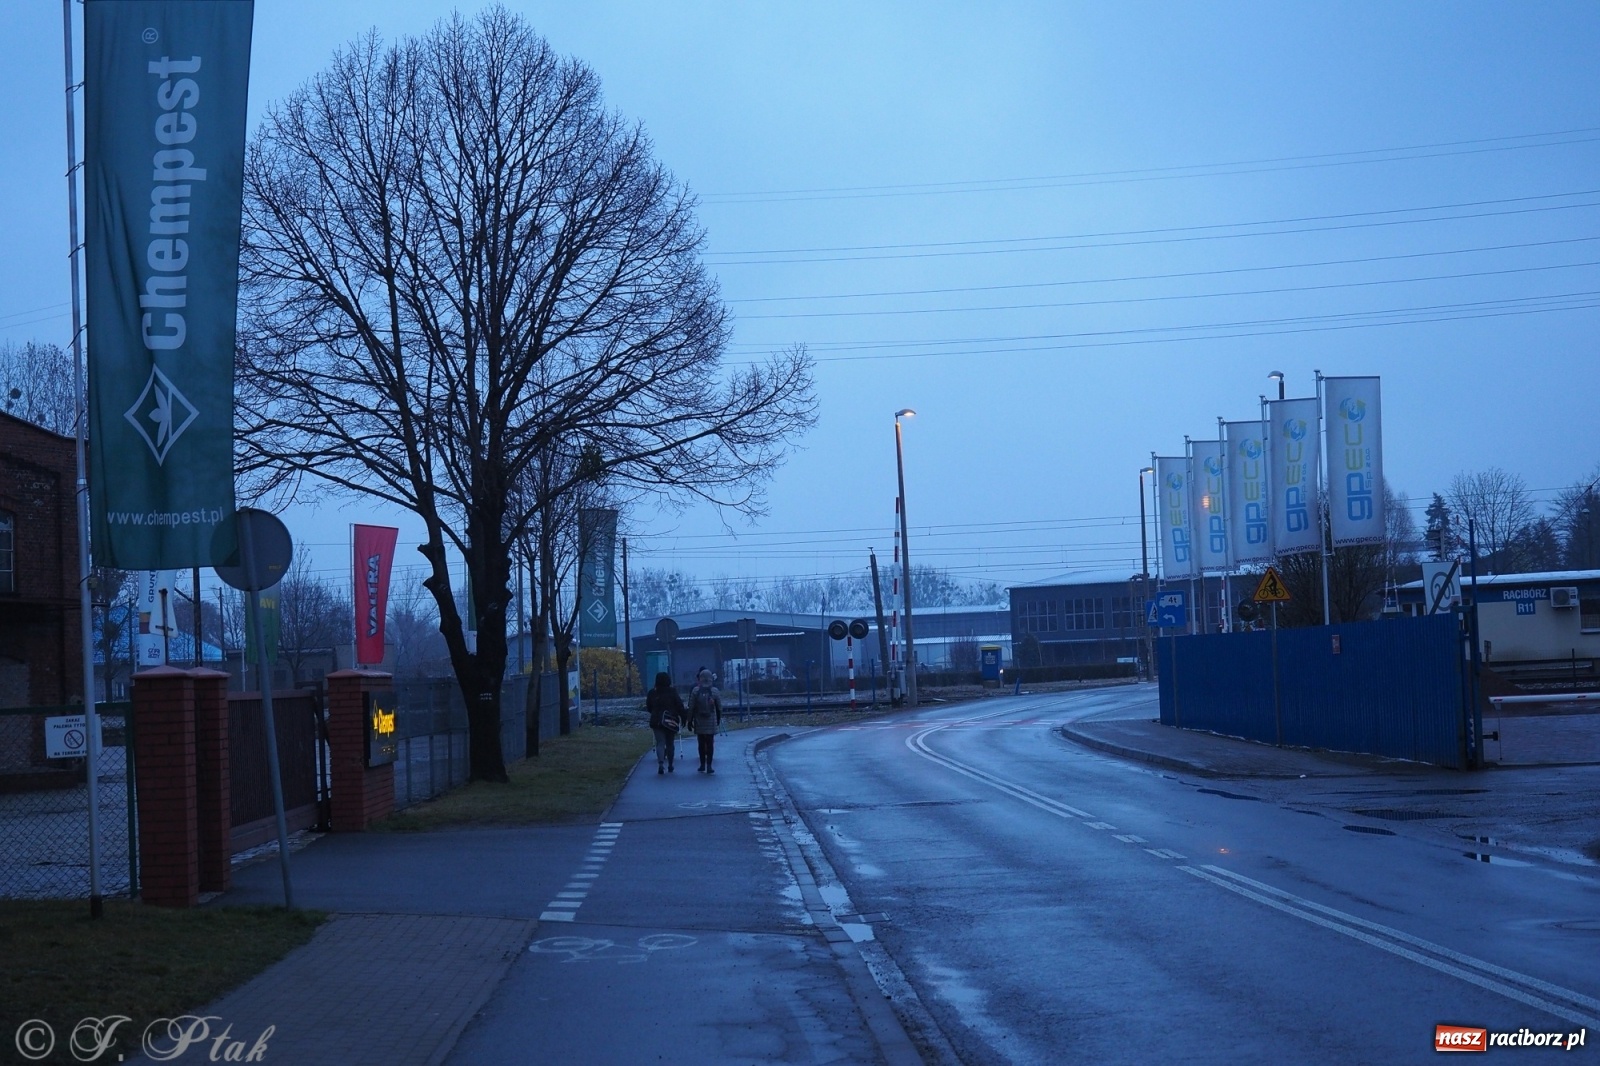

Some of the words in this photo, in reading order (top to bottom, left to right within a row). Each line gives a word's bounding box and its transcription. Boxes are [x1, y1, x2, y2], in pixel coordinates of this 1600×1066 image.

[138, 55, 207, 351] Chempest
[1334, 534, 1385, 545] www.gpeco.pl
[148, 570, 156, 603] GRUN
[1503, 587, 1547, 600] RACIBÓRZ
[1518, 602, 1534, 613] R11
